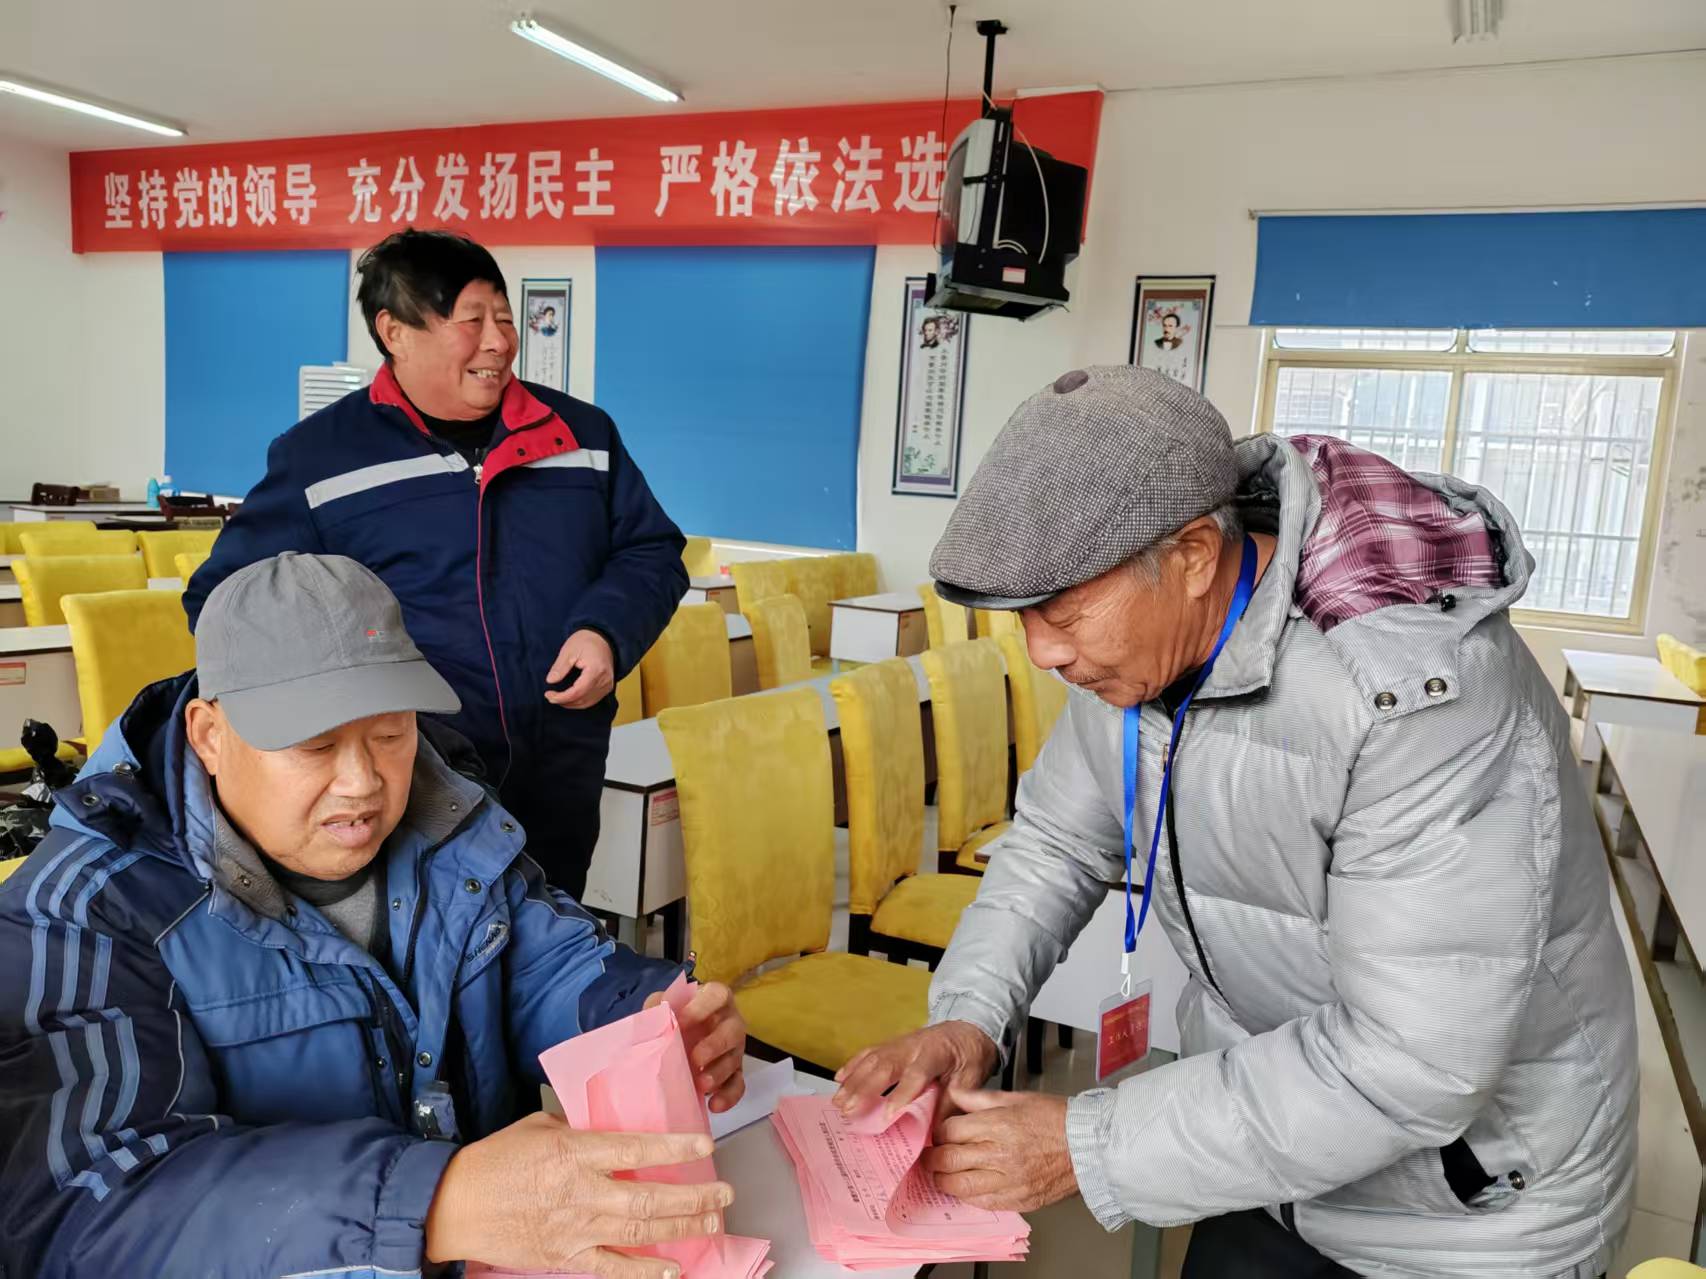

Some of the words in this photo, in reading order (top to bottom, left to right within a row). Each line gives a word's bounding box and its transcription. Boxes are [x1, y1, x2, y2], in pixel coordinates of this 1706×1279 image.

[104, 164, 318, 229] 坚持党的领导
[348, 148, 615, 223] 充分发扬民主
